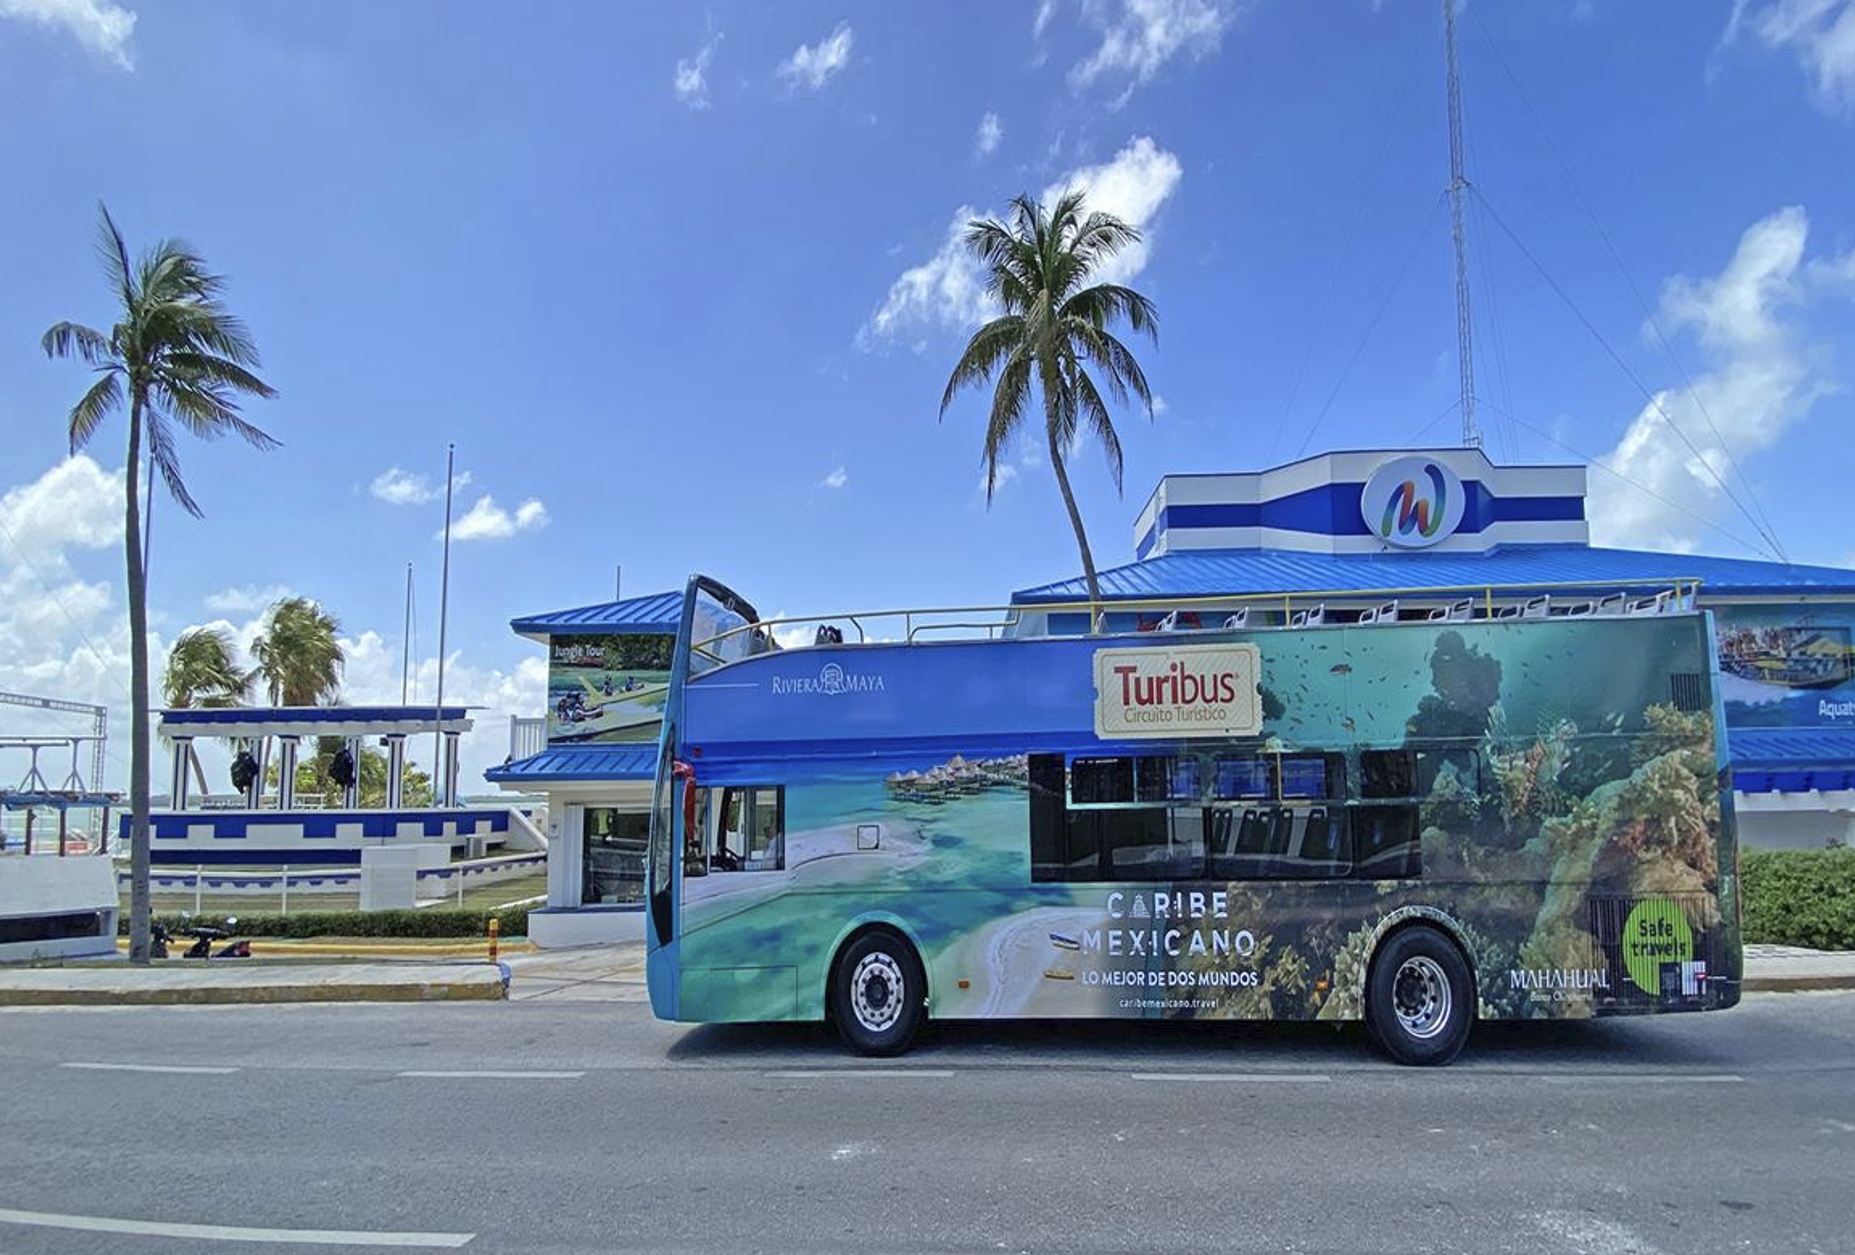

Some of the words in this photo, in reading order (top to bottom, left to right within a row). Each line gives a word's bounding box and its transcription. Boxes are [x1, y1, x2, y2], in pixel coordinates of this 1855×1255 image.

[555, 645, 583, 659] Jungle
[585, 645, 604, 656] Tour
[772, 676, 821, 694] RIVIERA
[844, 675, 885, 692] MAYA
[1114, 661, 1235, 706] Turibus
[1124, 706, 1172, 723] Circuito
[1107, 892, 1228, 919] CARIBE
[1640, 917, 1673, 937] Safe
[1082, 929, 1255, 957] MEXICANO
[1631, 938, 1686, 957] travels
[1081, 972, 1099, 985] LO
[1102, 971, 1145, 986] MEJOR
[1148, 971, 1166, 986] DE
[1168, 971, 1195, 986] DOS
[1198, 971, 1258, 986] MUNDOS
[1510, 968, 1610, 990] MAHAHUAL
